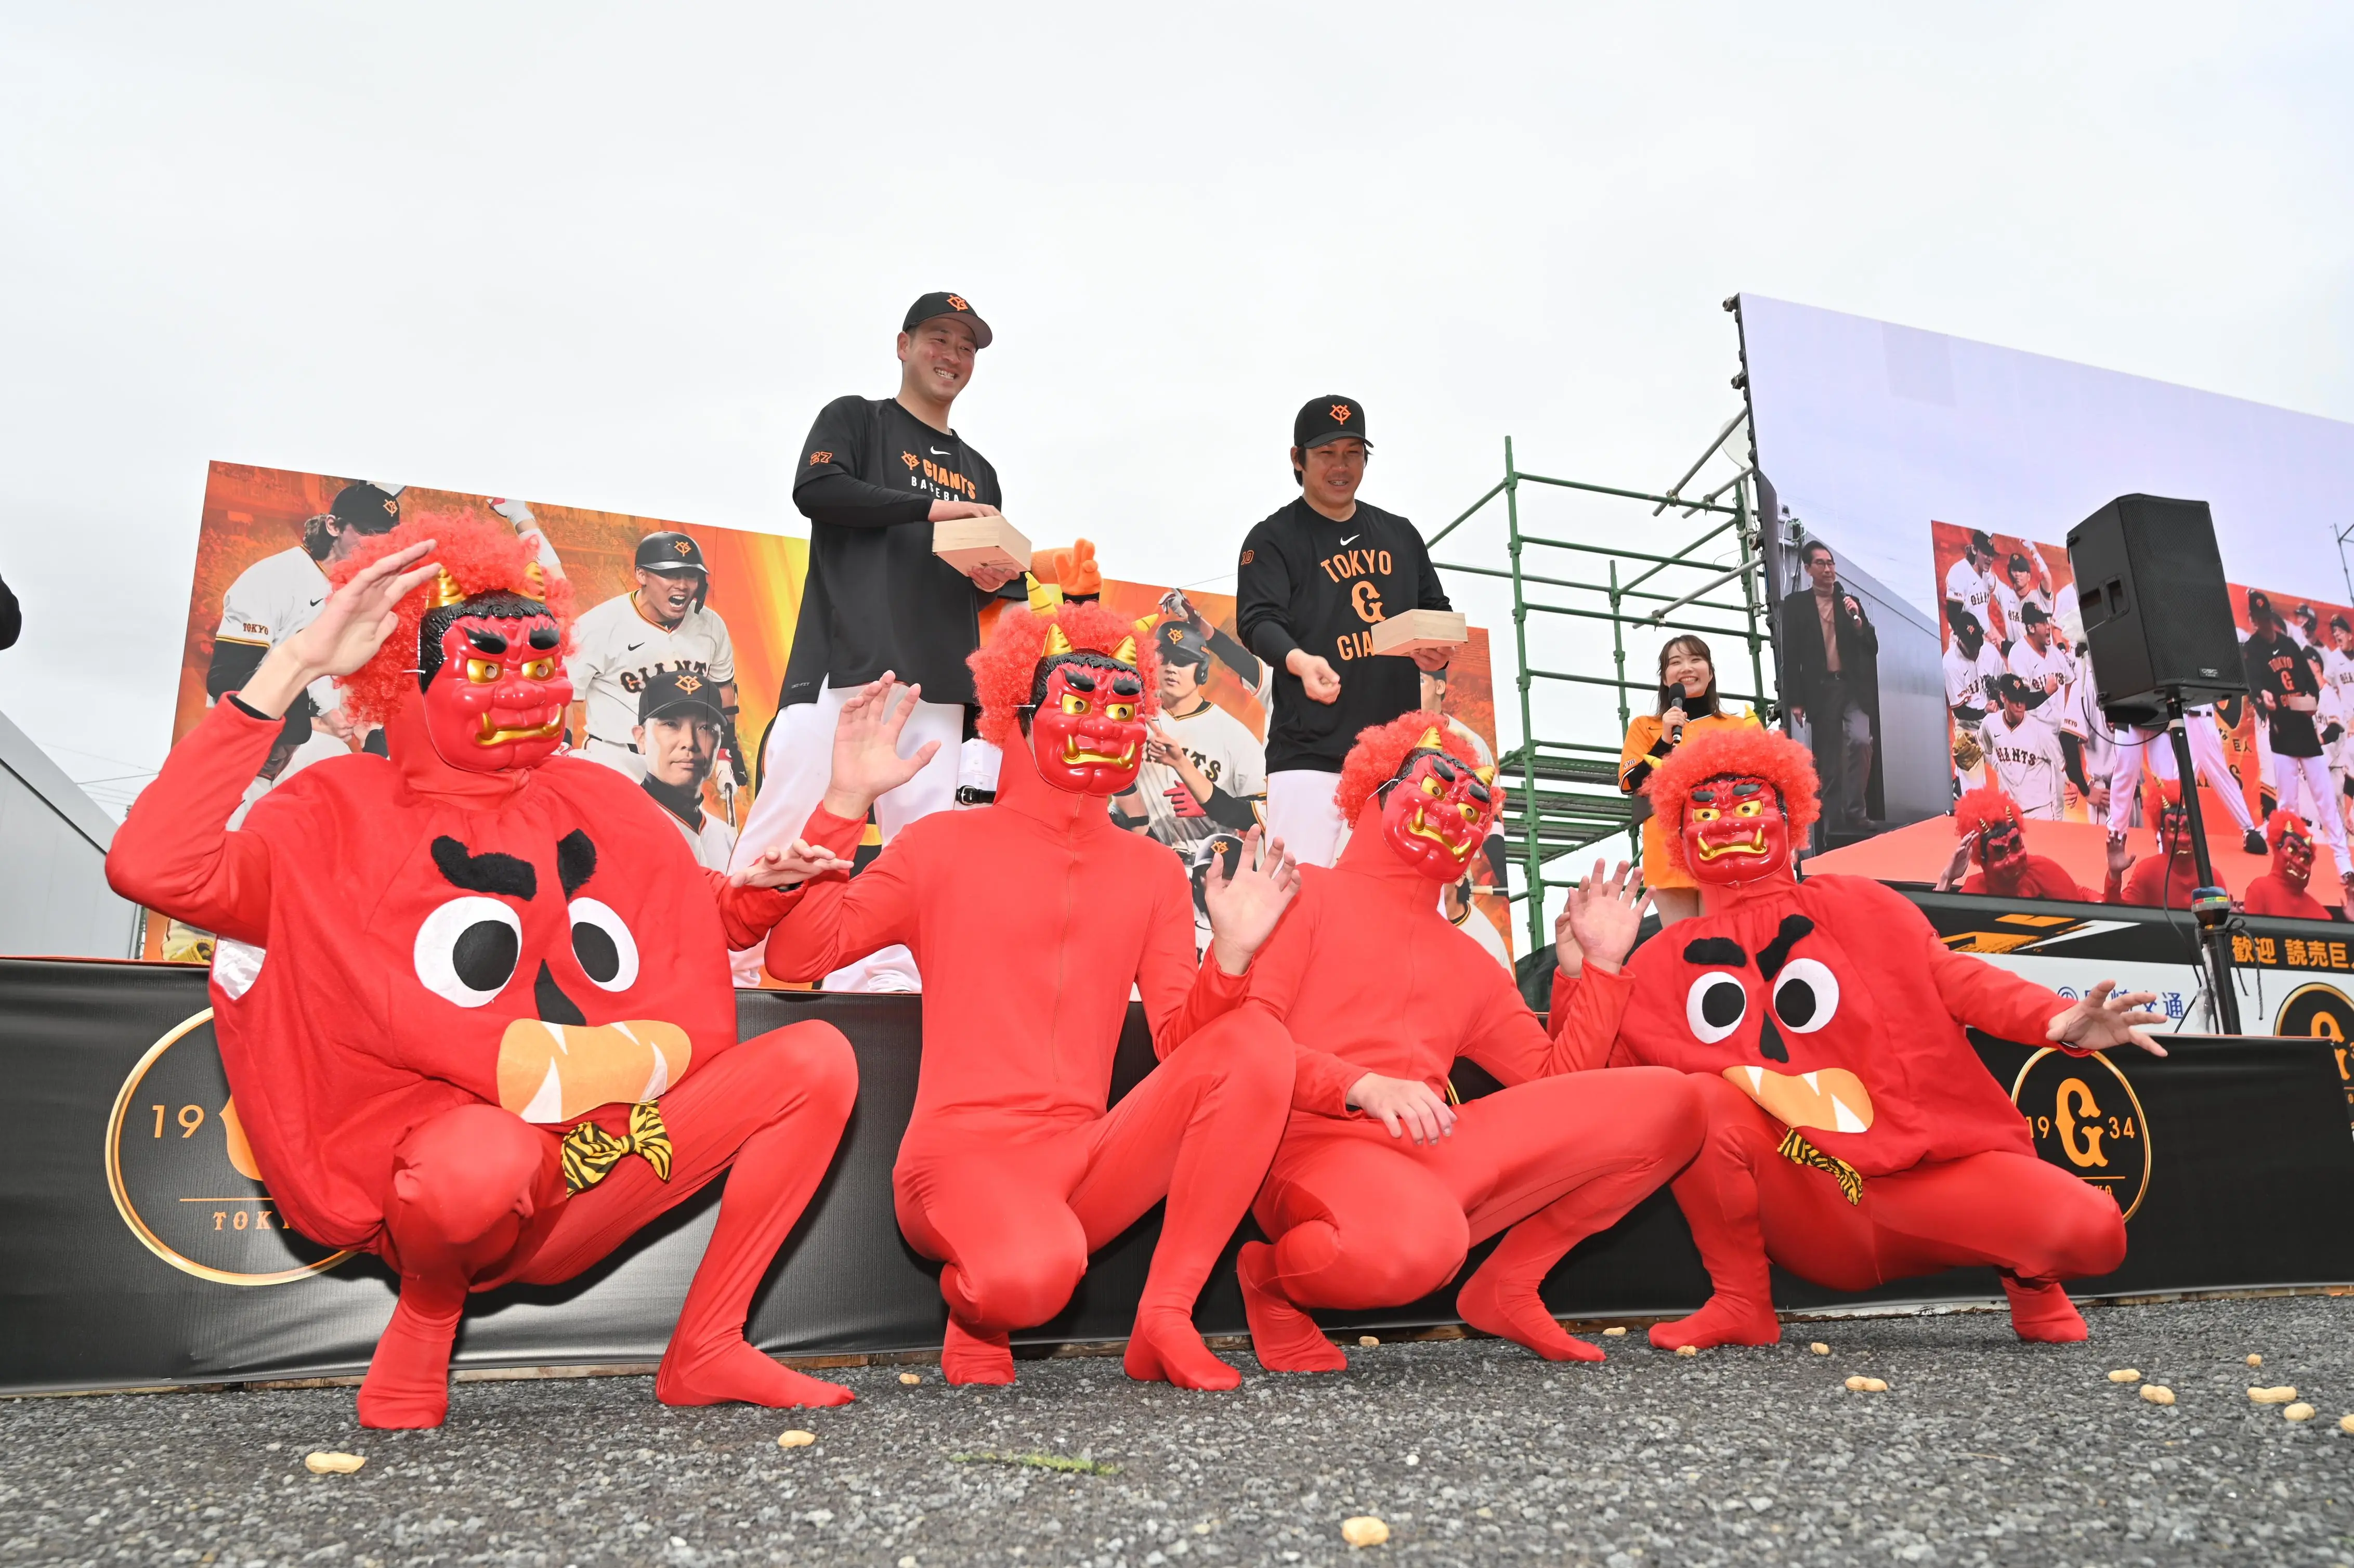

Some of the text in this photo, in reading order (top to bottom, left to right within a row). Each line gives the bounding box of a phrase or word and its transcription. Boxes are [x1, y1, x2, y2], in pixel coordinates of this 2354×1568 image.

[809, 451, 832, 466] 27
[911, 476, 960, 502] BASEBA
[923, 459, 976, 500] GIANTS
[1240, 550, 1254, 565] 10
[1320, 549, 1392, 583] TOKYO
[1352, 580, 1386, 623] G
[242, 622, 269, 635] TOKYO
[1337, 631, 1376, 661] GIA
[1995, 747, 2036, 766] GIANTS
[2231, 935, 2354, 969] 歓迎 読売巨
[152, 1104, 204, 1138] 19
[2025, 1077, 2135, 1168] 19 G 34
